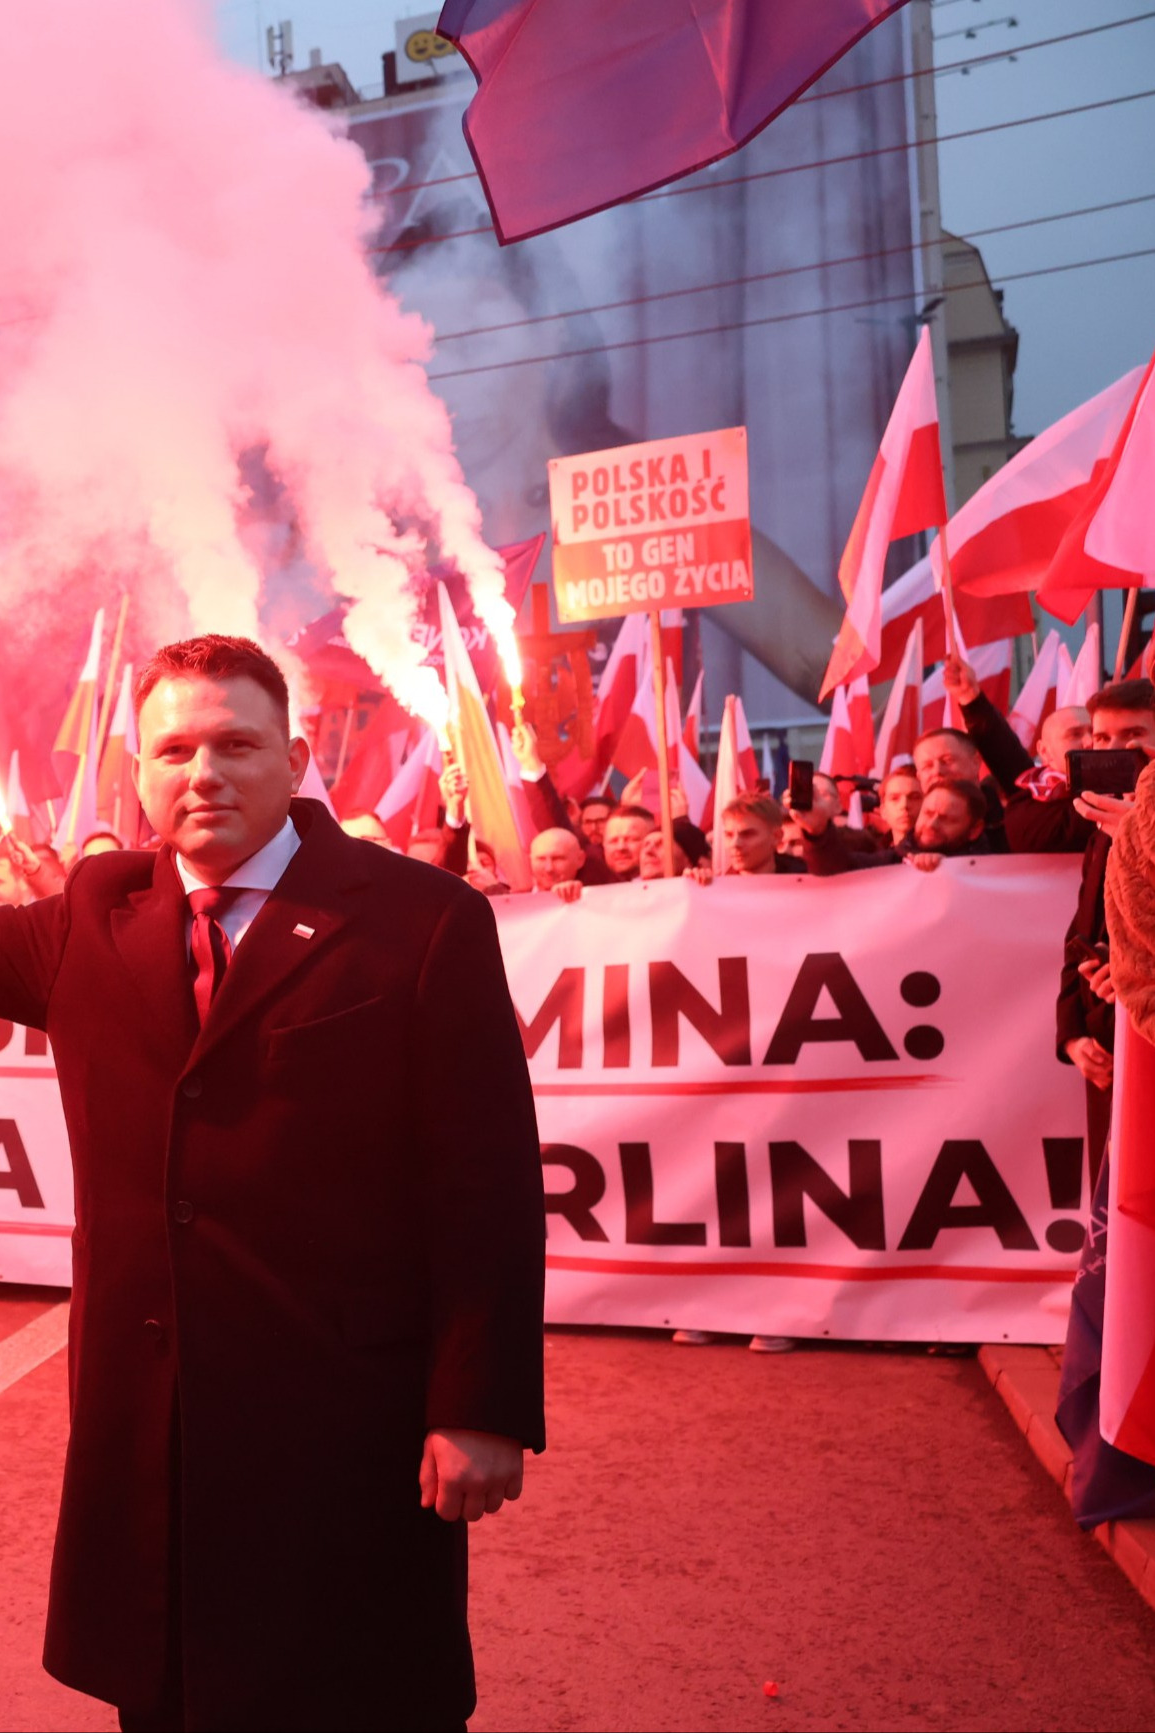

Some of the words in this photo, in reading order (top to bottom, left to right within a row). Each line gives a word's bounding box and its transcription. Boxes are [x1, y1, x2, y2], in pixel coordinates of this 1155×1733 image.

[572, 453, 689, 500] POLSKA
[703, 449, 711, 479] I
[572, 475, 725, 533] POLSKOŚĆ
[602, 542, 634, 572] TO
[641, 533, 695, 567] GEN
[566, 570, 666, 609] MOJEGO
[673, 560, 750, 597] ŻYCIA
